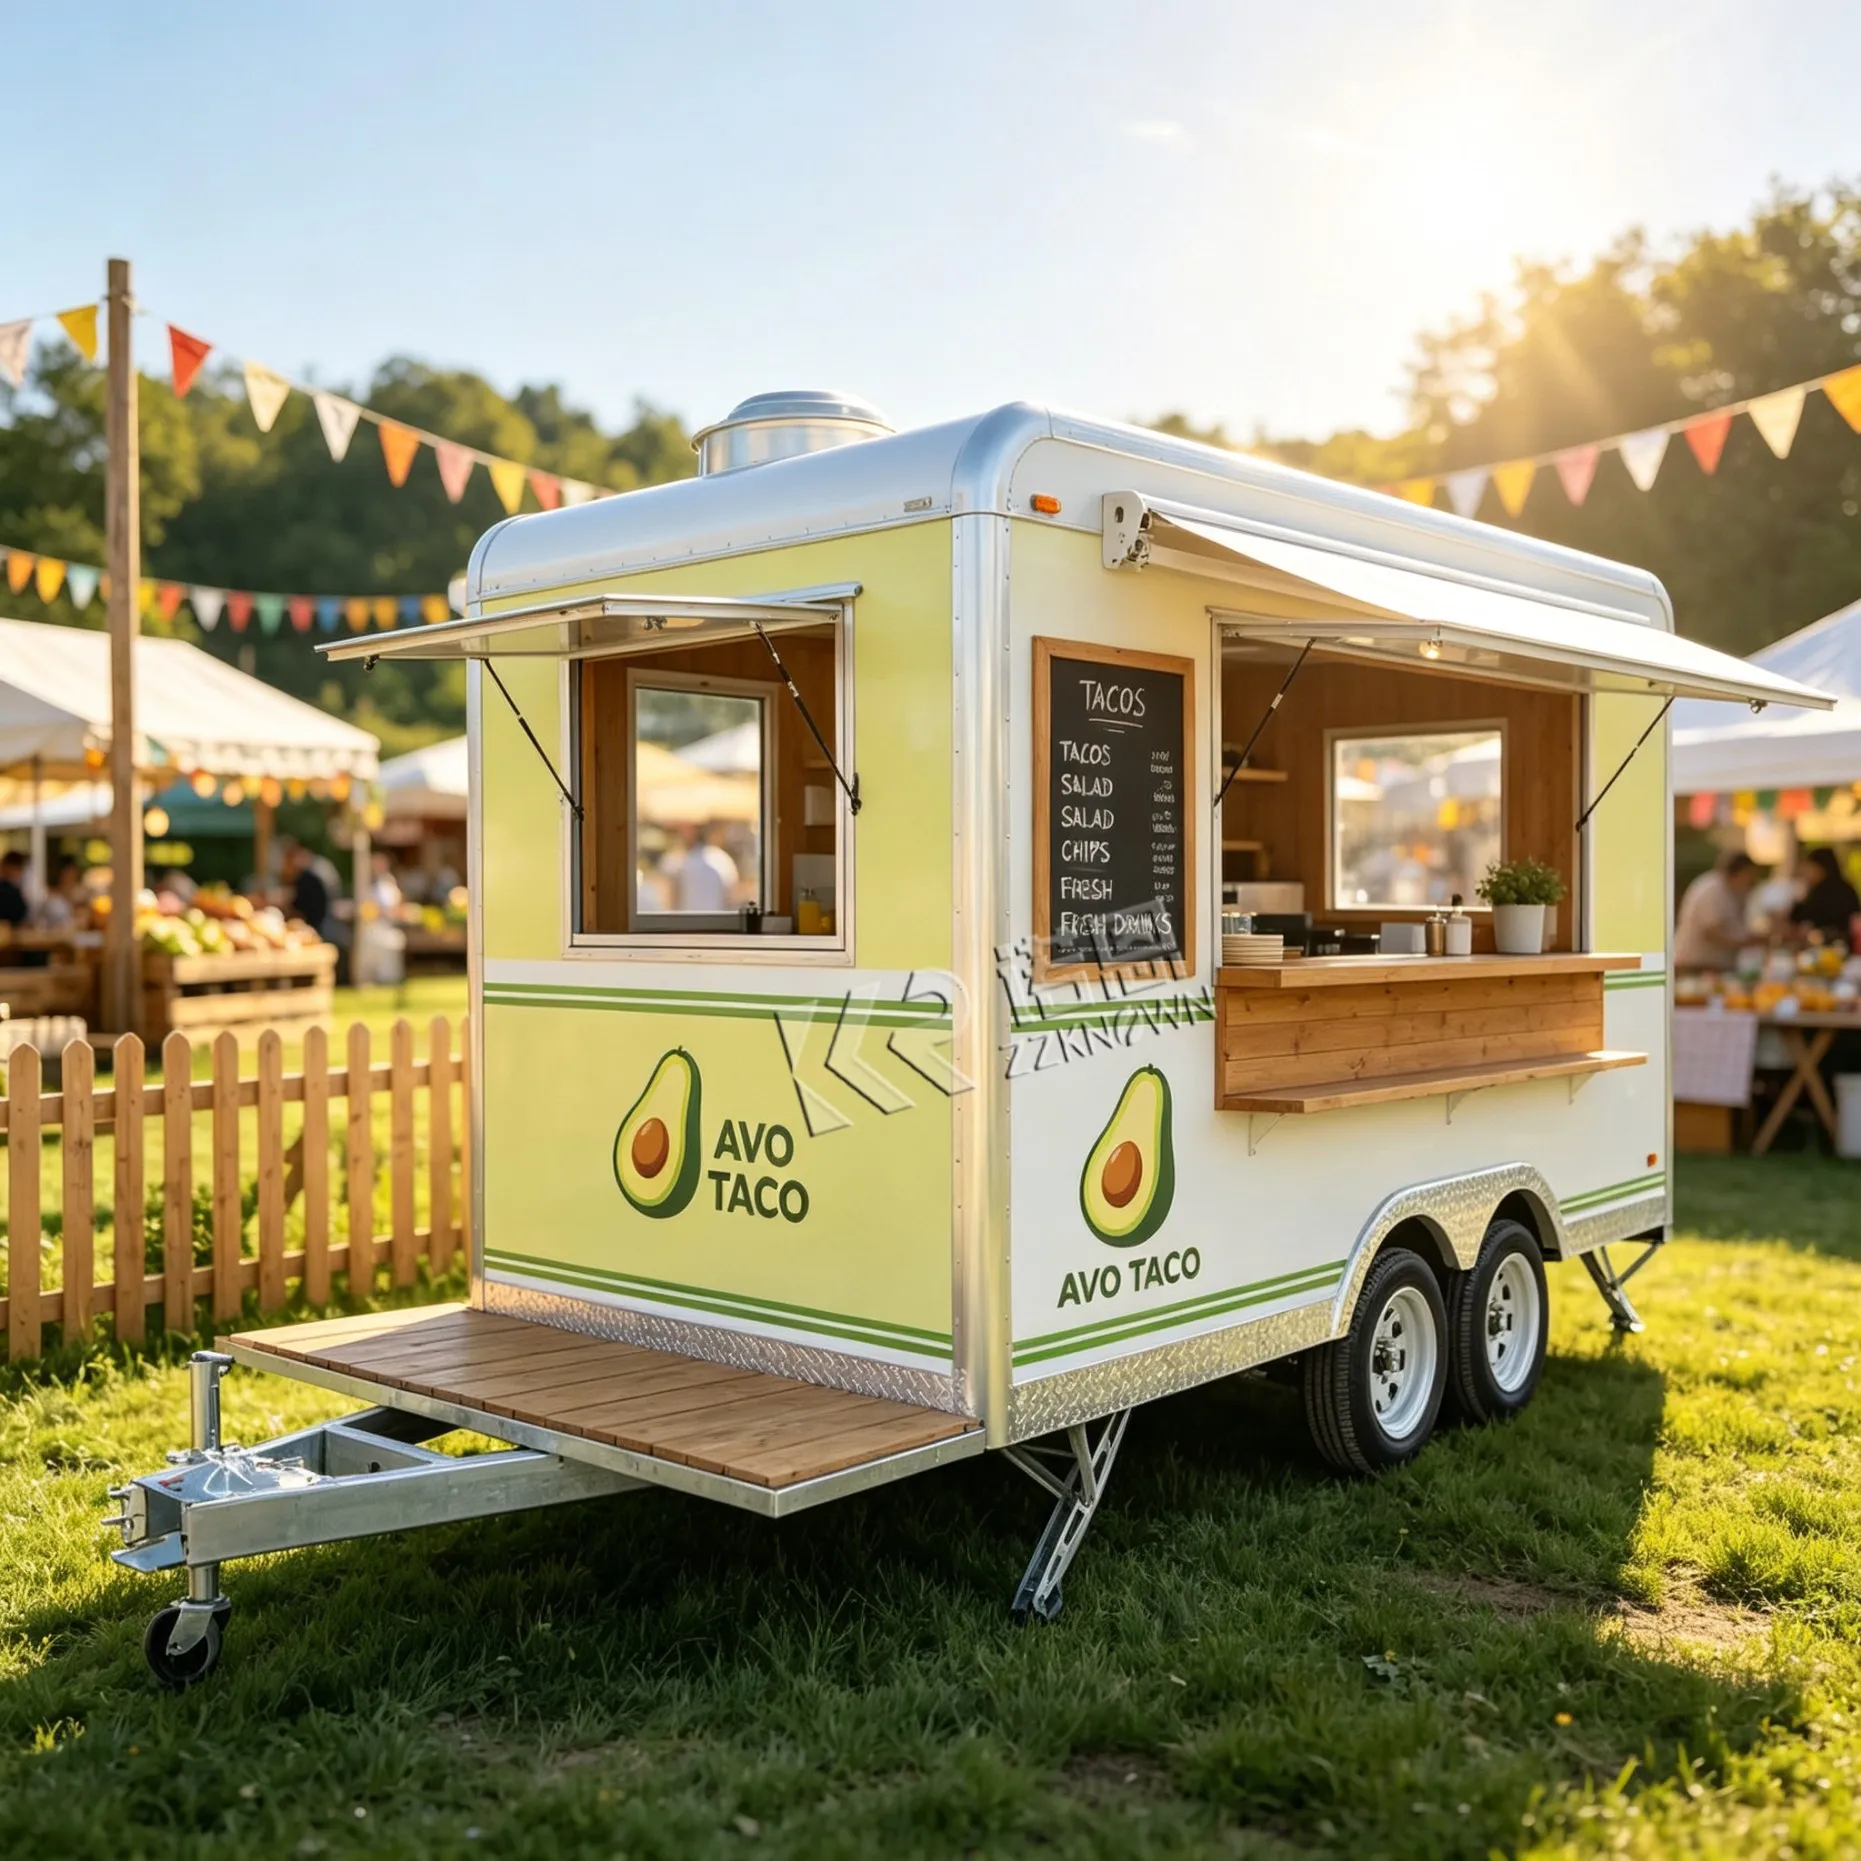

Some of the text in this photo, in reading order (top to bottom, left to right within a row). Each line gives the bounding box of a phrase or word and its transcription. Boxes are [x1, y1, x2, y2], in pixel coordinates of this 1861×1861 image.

[1079, 679, 1146, 717] TACOS
[1059, 740, 1111, 766] TACOS
[1061, 773, 1113, 797] SALAD
[1061, 805, 1114, 829] SALAD
[1061, 840, 1111, 863] CHIPS
[1060, 876, 1113, 900] FRESH
[713, 1119, 794, 1168] AVO
[707, 1169, 809, 1223] TACO
[1057, 1246, 1201, 1308] AVO TACO
